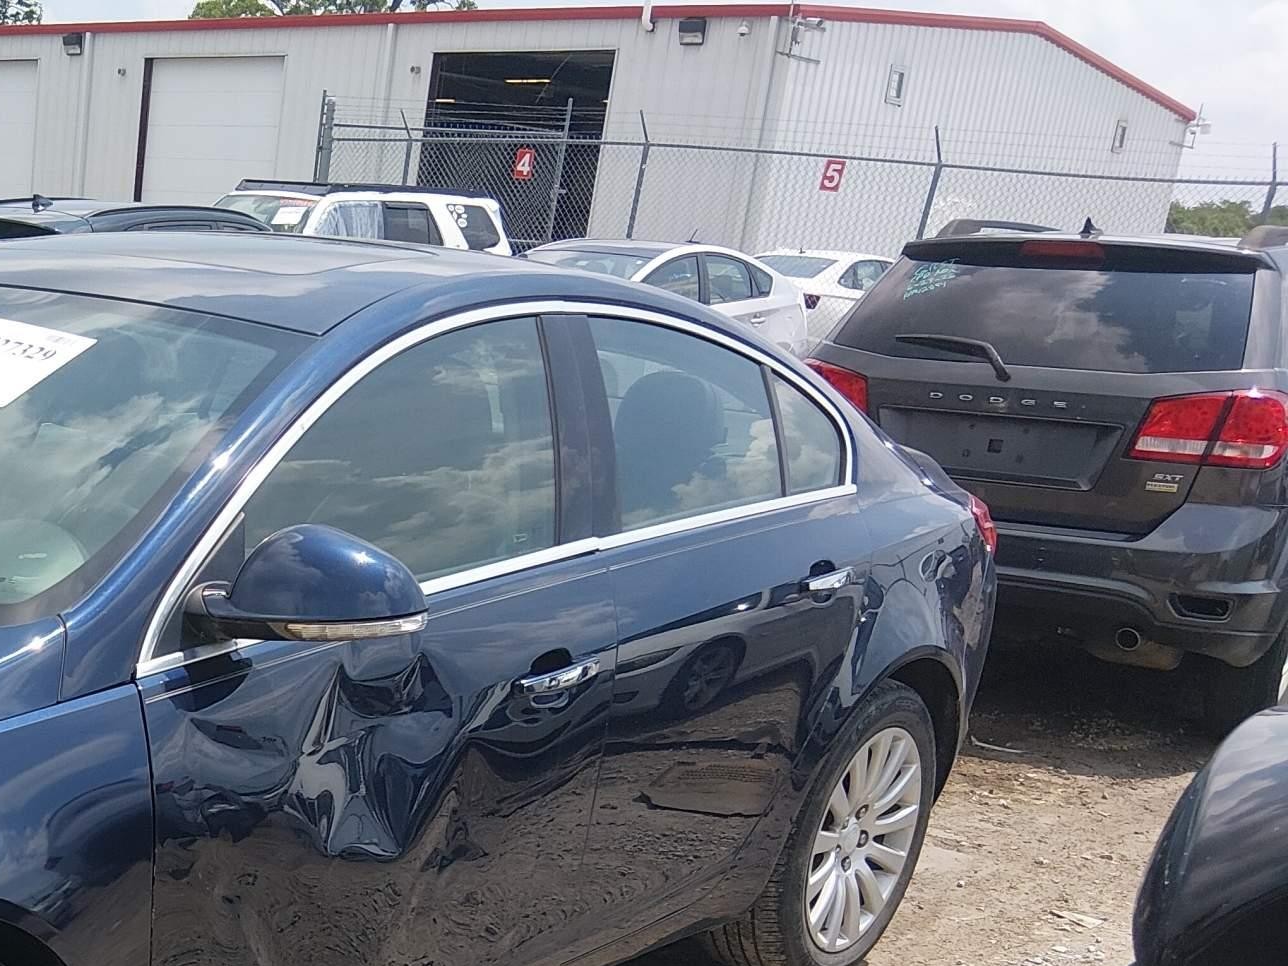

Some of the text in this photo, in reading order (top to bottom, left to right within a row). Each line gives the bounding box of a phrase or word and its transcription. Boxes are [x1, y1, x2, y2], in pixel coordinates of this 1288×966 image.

[516, 152, 532, 176] 4
[823, 163, 842, 188] 5
[929, 391, 1068, 409] DODGE
[1152, 473, 1184, 481] SXT
